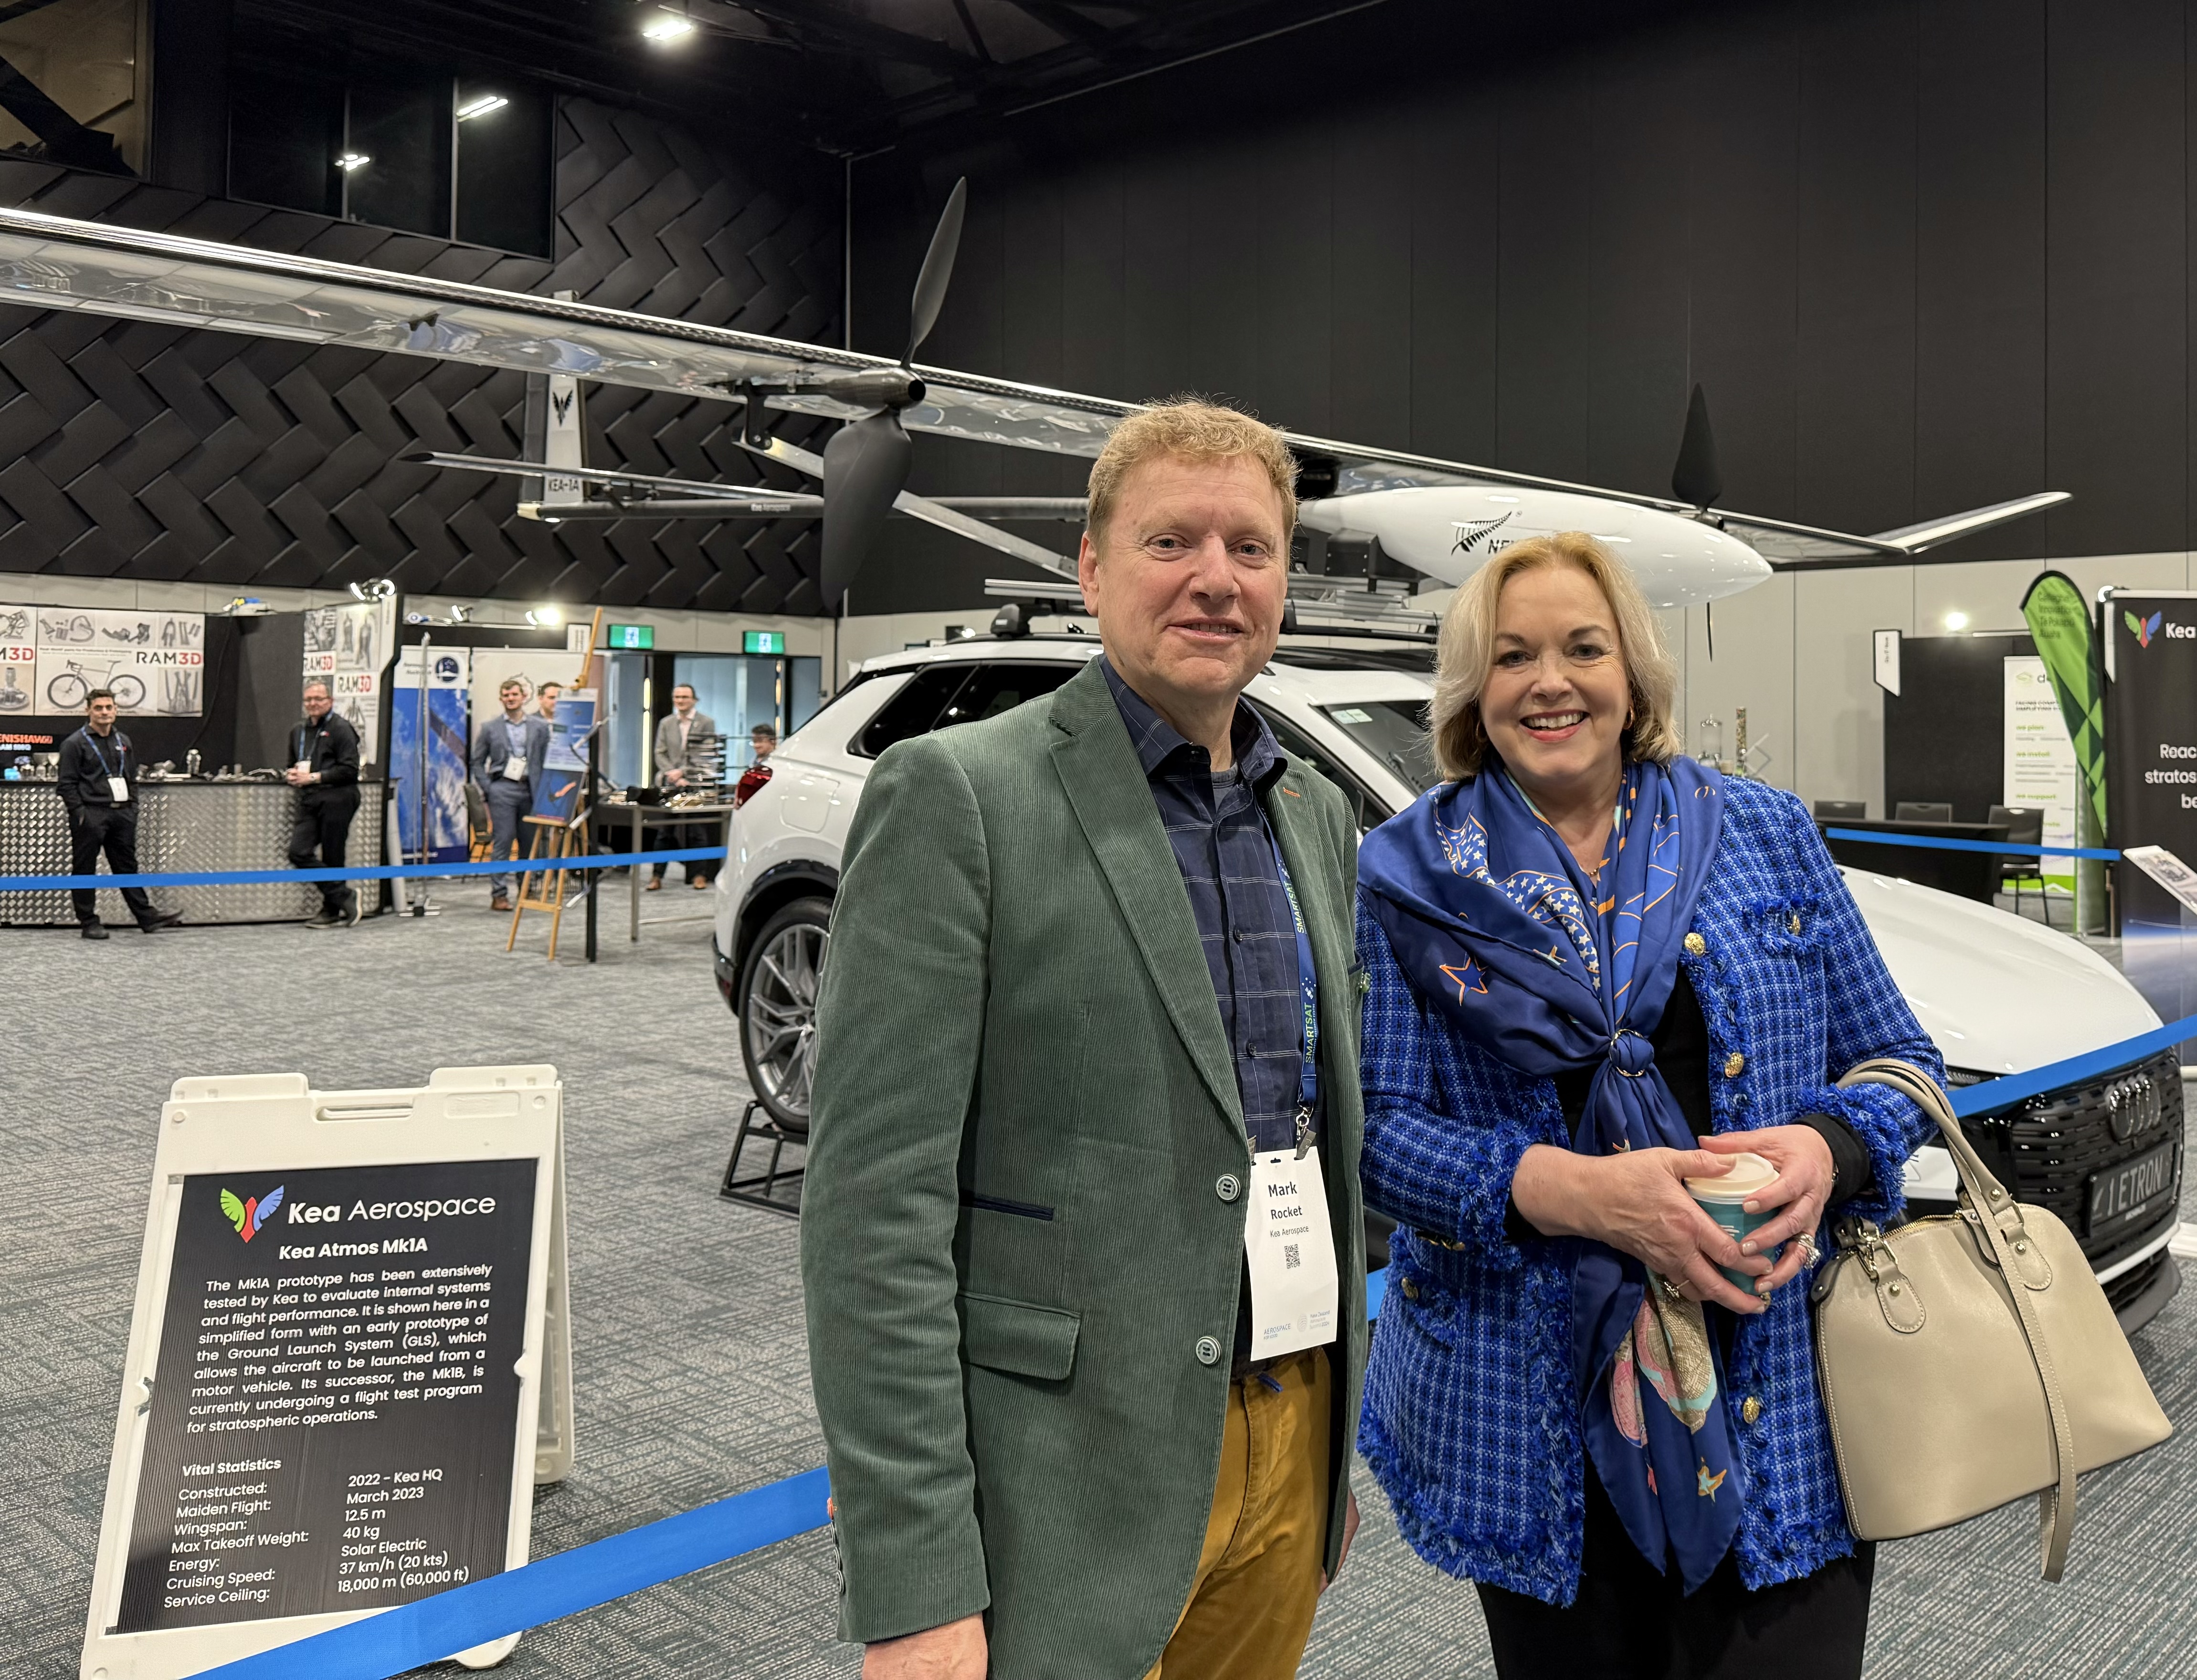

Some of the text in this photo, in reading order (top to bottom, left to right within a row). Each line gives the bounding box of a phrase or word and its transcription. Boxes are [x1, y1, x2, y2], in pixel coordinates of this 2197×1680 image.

[2165, 622, 2196, 639] Kea
[136, 651, 202, 666] RAM3D
[2160, 743, 2197, 759] Reac
[2145, 769, 2197, 784] stratos
[1304, 1002, 1315, 1064] SMARTSAT
[1268, 1181, 1298, 1197] Mark
[288, 1197, 496, 1224] Kea Aerospace
[1270, 1205, 1303, 1220] Rocket
[1270, 1226, 1309, 1238] Kea Aerospace
[279, 1237, 428, 1260] Kea Atmos Mk1A
[206, 1264, 493, 1292] The Mk1A prototype has been extensively
[204, 1282, 491, 1309] tested by Kea to evaluate internal systems
[201, 1298, 490, 1327] and flight performance. It is shown here in a
[199, 1313, 489, 1346] simplified form with an early prototype of
[1263, 1323, 1291, 1335] AEROSPACE
[197, 1331, 487, 1362] the Ground Launch System (GLS), which
[194, 1350, 486, 1379] allows the aircraft to be launched from a
[191, 1365, 484, 1397] motor vehicle. Its successor, the Mk1B, is
[189, 1384, 483, 1415] currently undergoing a flight test program
[187, 1409, 378, 1433] for stratospheric operations.
[182, 1458, 282, 1477] Vital Statistics
[348, 1473, 380, 1487] 2022
[394, 1471, 420, 1483] Kea
[422, 1469, 443, 1481] HQ
[179, 1481, 267, 1500] Constructed:
[347, 1486, 424, 1504] March 2023
[176, 1500, 271, 1518] Maiden Flight:
[345, 1508, 386, 1522] 12.5 m
[174, 1520, 247, 1537] Wingspan:
[342, 1525, 380, 1540] 40 kg
[171, 1531, 309, 1554] Max Takeoff Weight:
[341, 1538, 427, 1557] Solar Electric
[169, 1558, 220, 1573] Energy:
[339, 1550, 448, 1574] 37 km/h (20 kts)
[166, 1568, 275, 1590] Cruising Speed:
[338, 1565, 469, 1593] 18,000 m (60,000 ft)
[164, 1588, 270, 1608] Service Ceiling:
